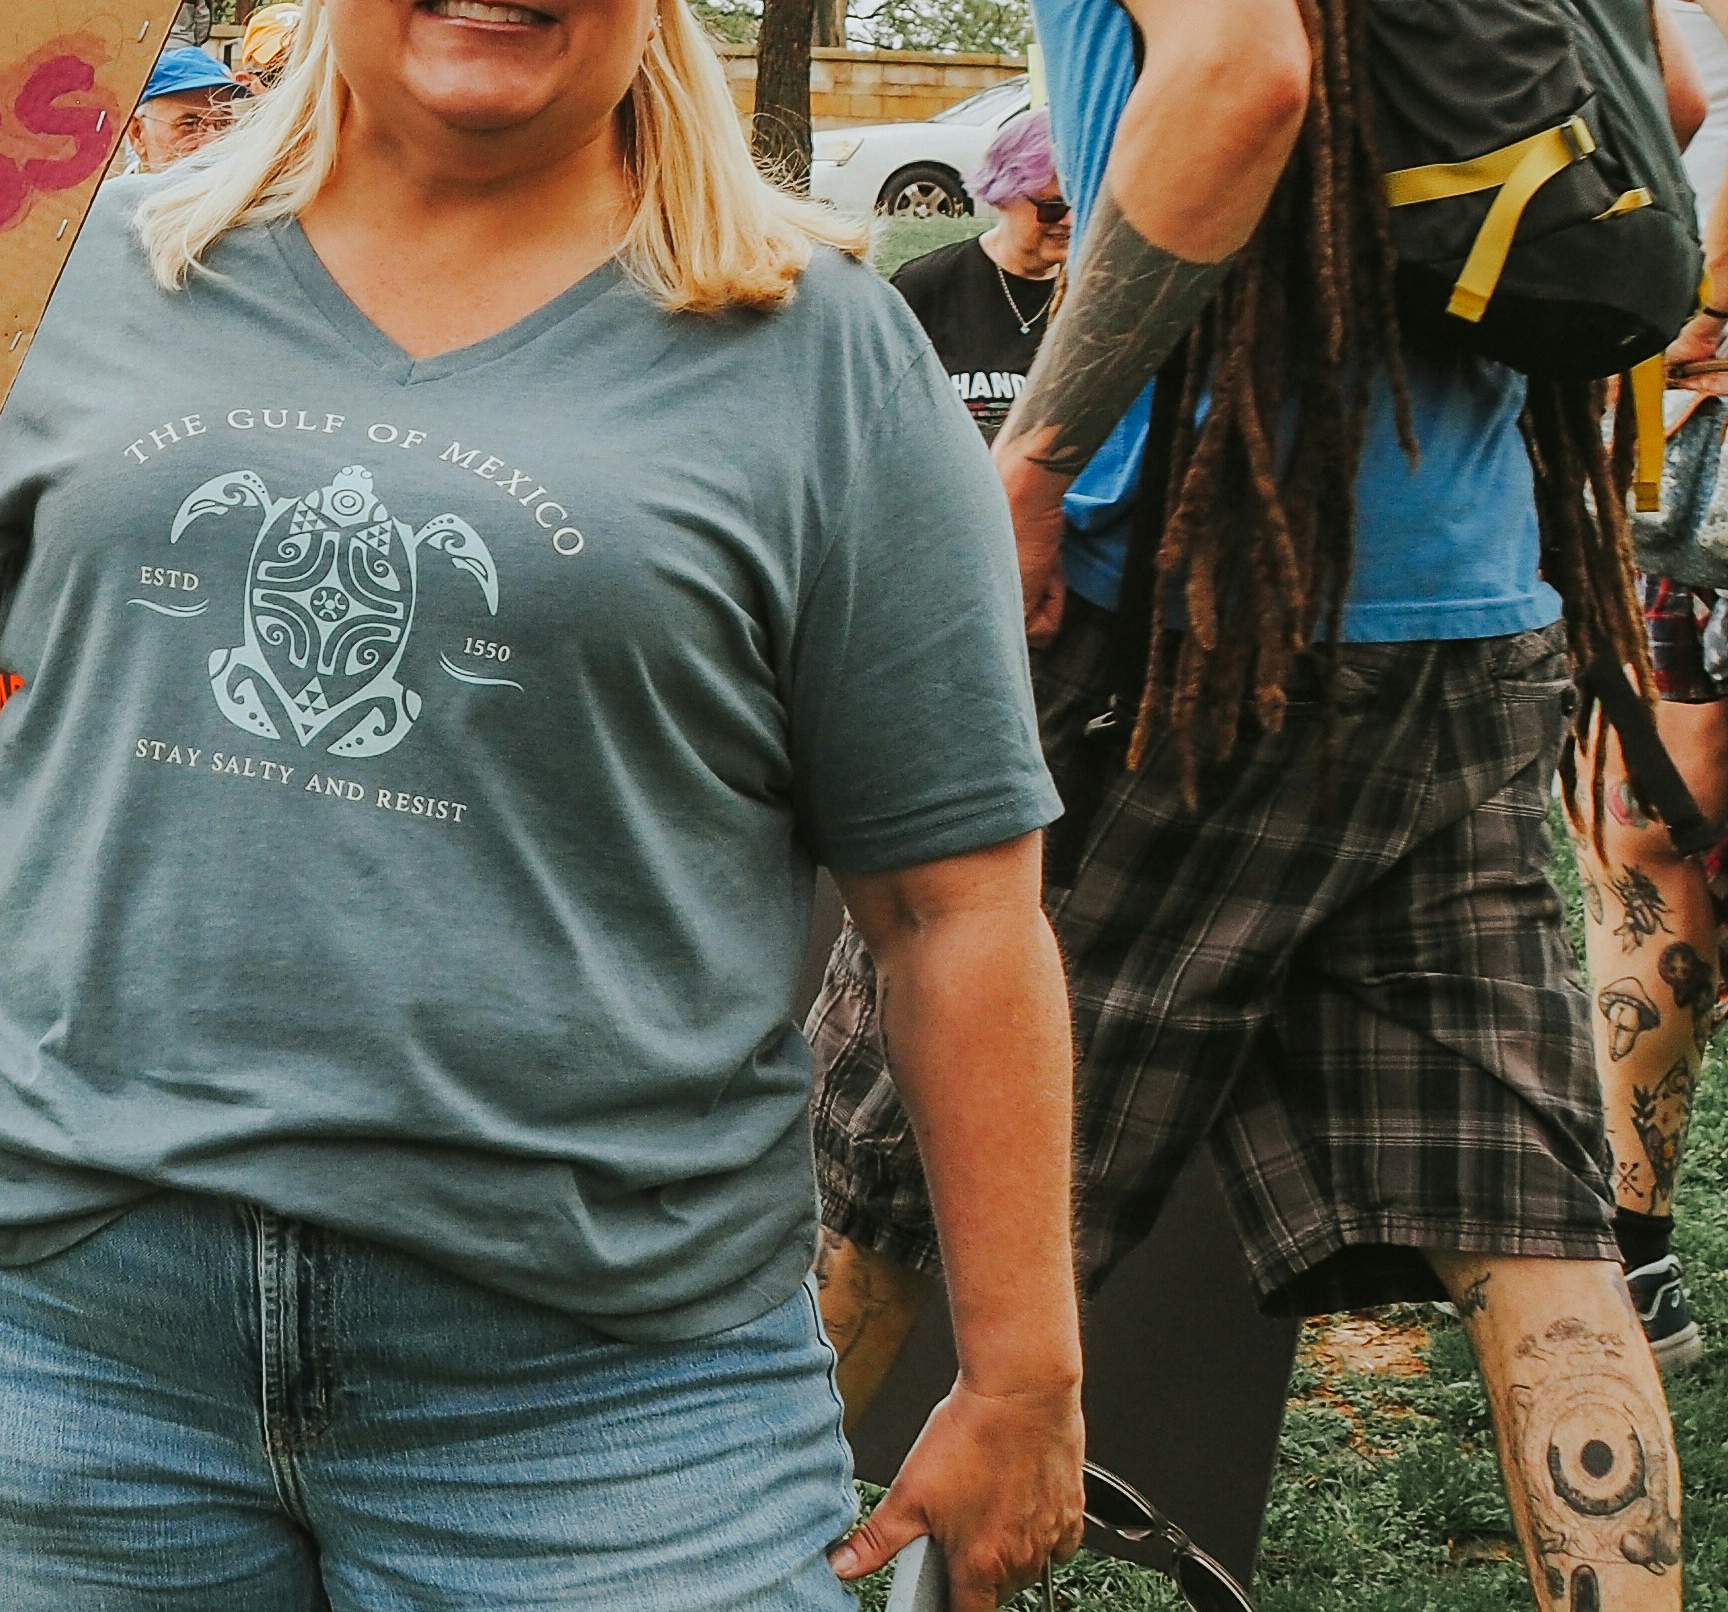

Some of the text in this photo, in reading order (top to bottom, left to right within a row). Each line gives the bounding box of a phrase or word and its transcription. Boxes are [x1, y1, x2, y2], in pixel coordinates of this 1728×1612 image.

[123, 407, 585, 556] THE GULF OF MEXICO
[140, 566, 200, 591] ESTD
[463, 637, 512, 663] 1550
[135, 739, 467, 823] STAY SALTY AND RESIST
